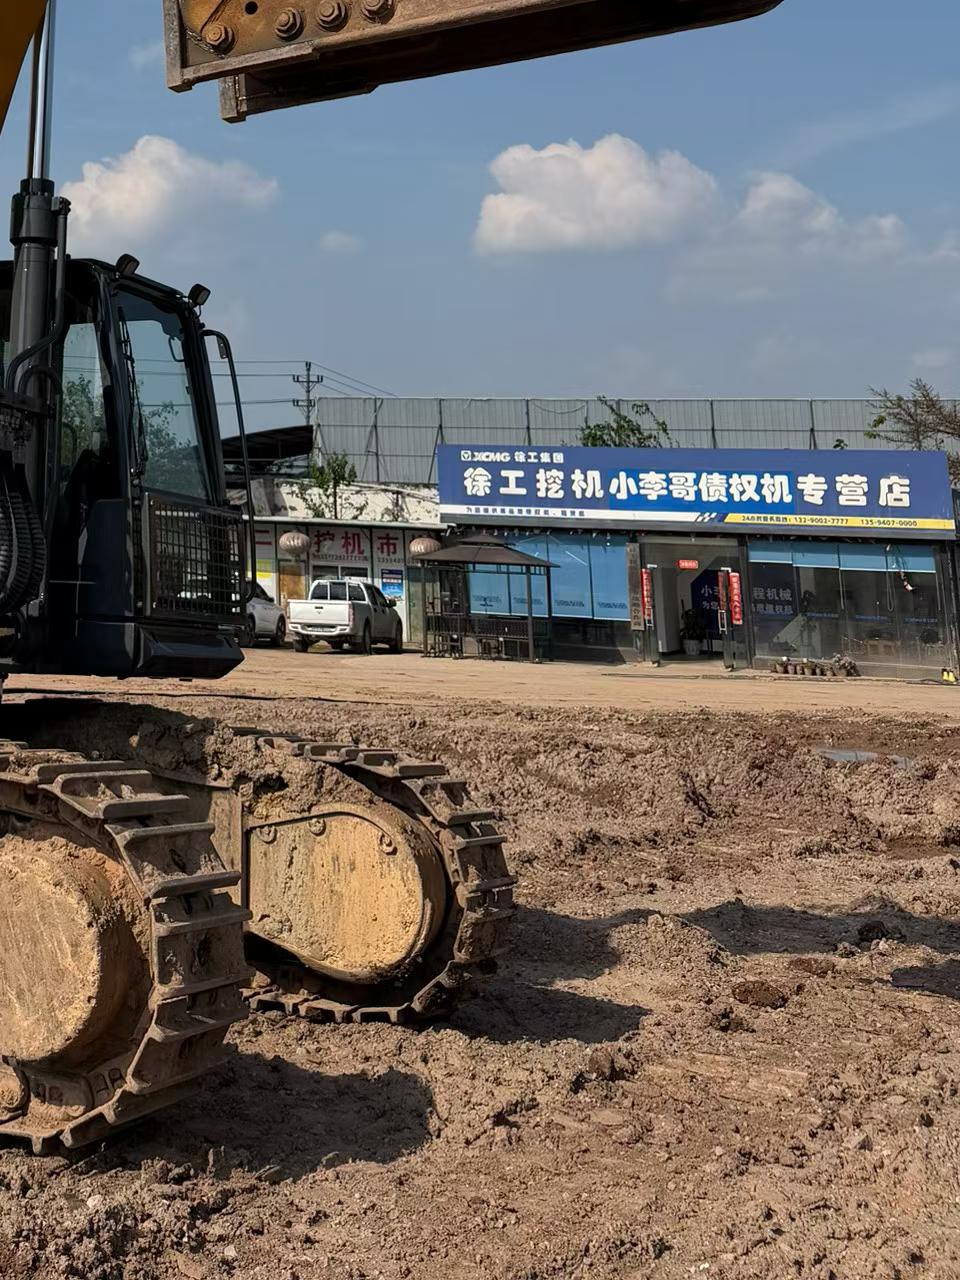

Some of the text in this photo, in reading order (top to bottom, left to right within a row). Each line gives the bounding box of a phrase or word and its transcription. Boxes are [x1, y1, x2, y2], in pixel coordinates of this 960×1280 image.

[472, 451, 564, 463] XCMG 徐工集团
[463, 467, 911, 508] 徐工挖机小李哥债权机专营店
